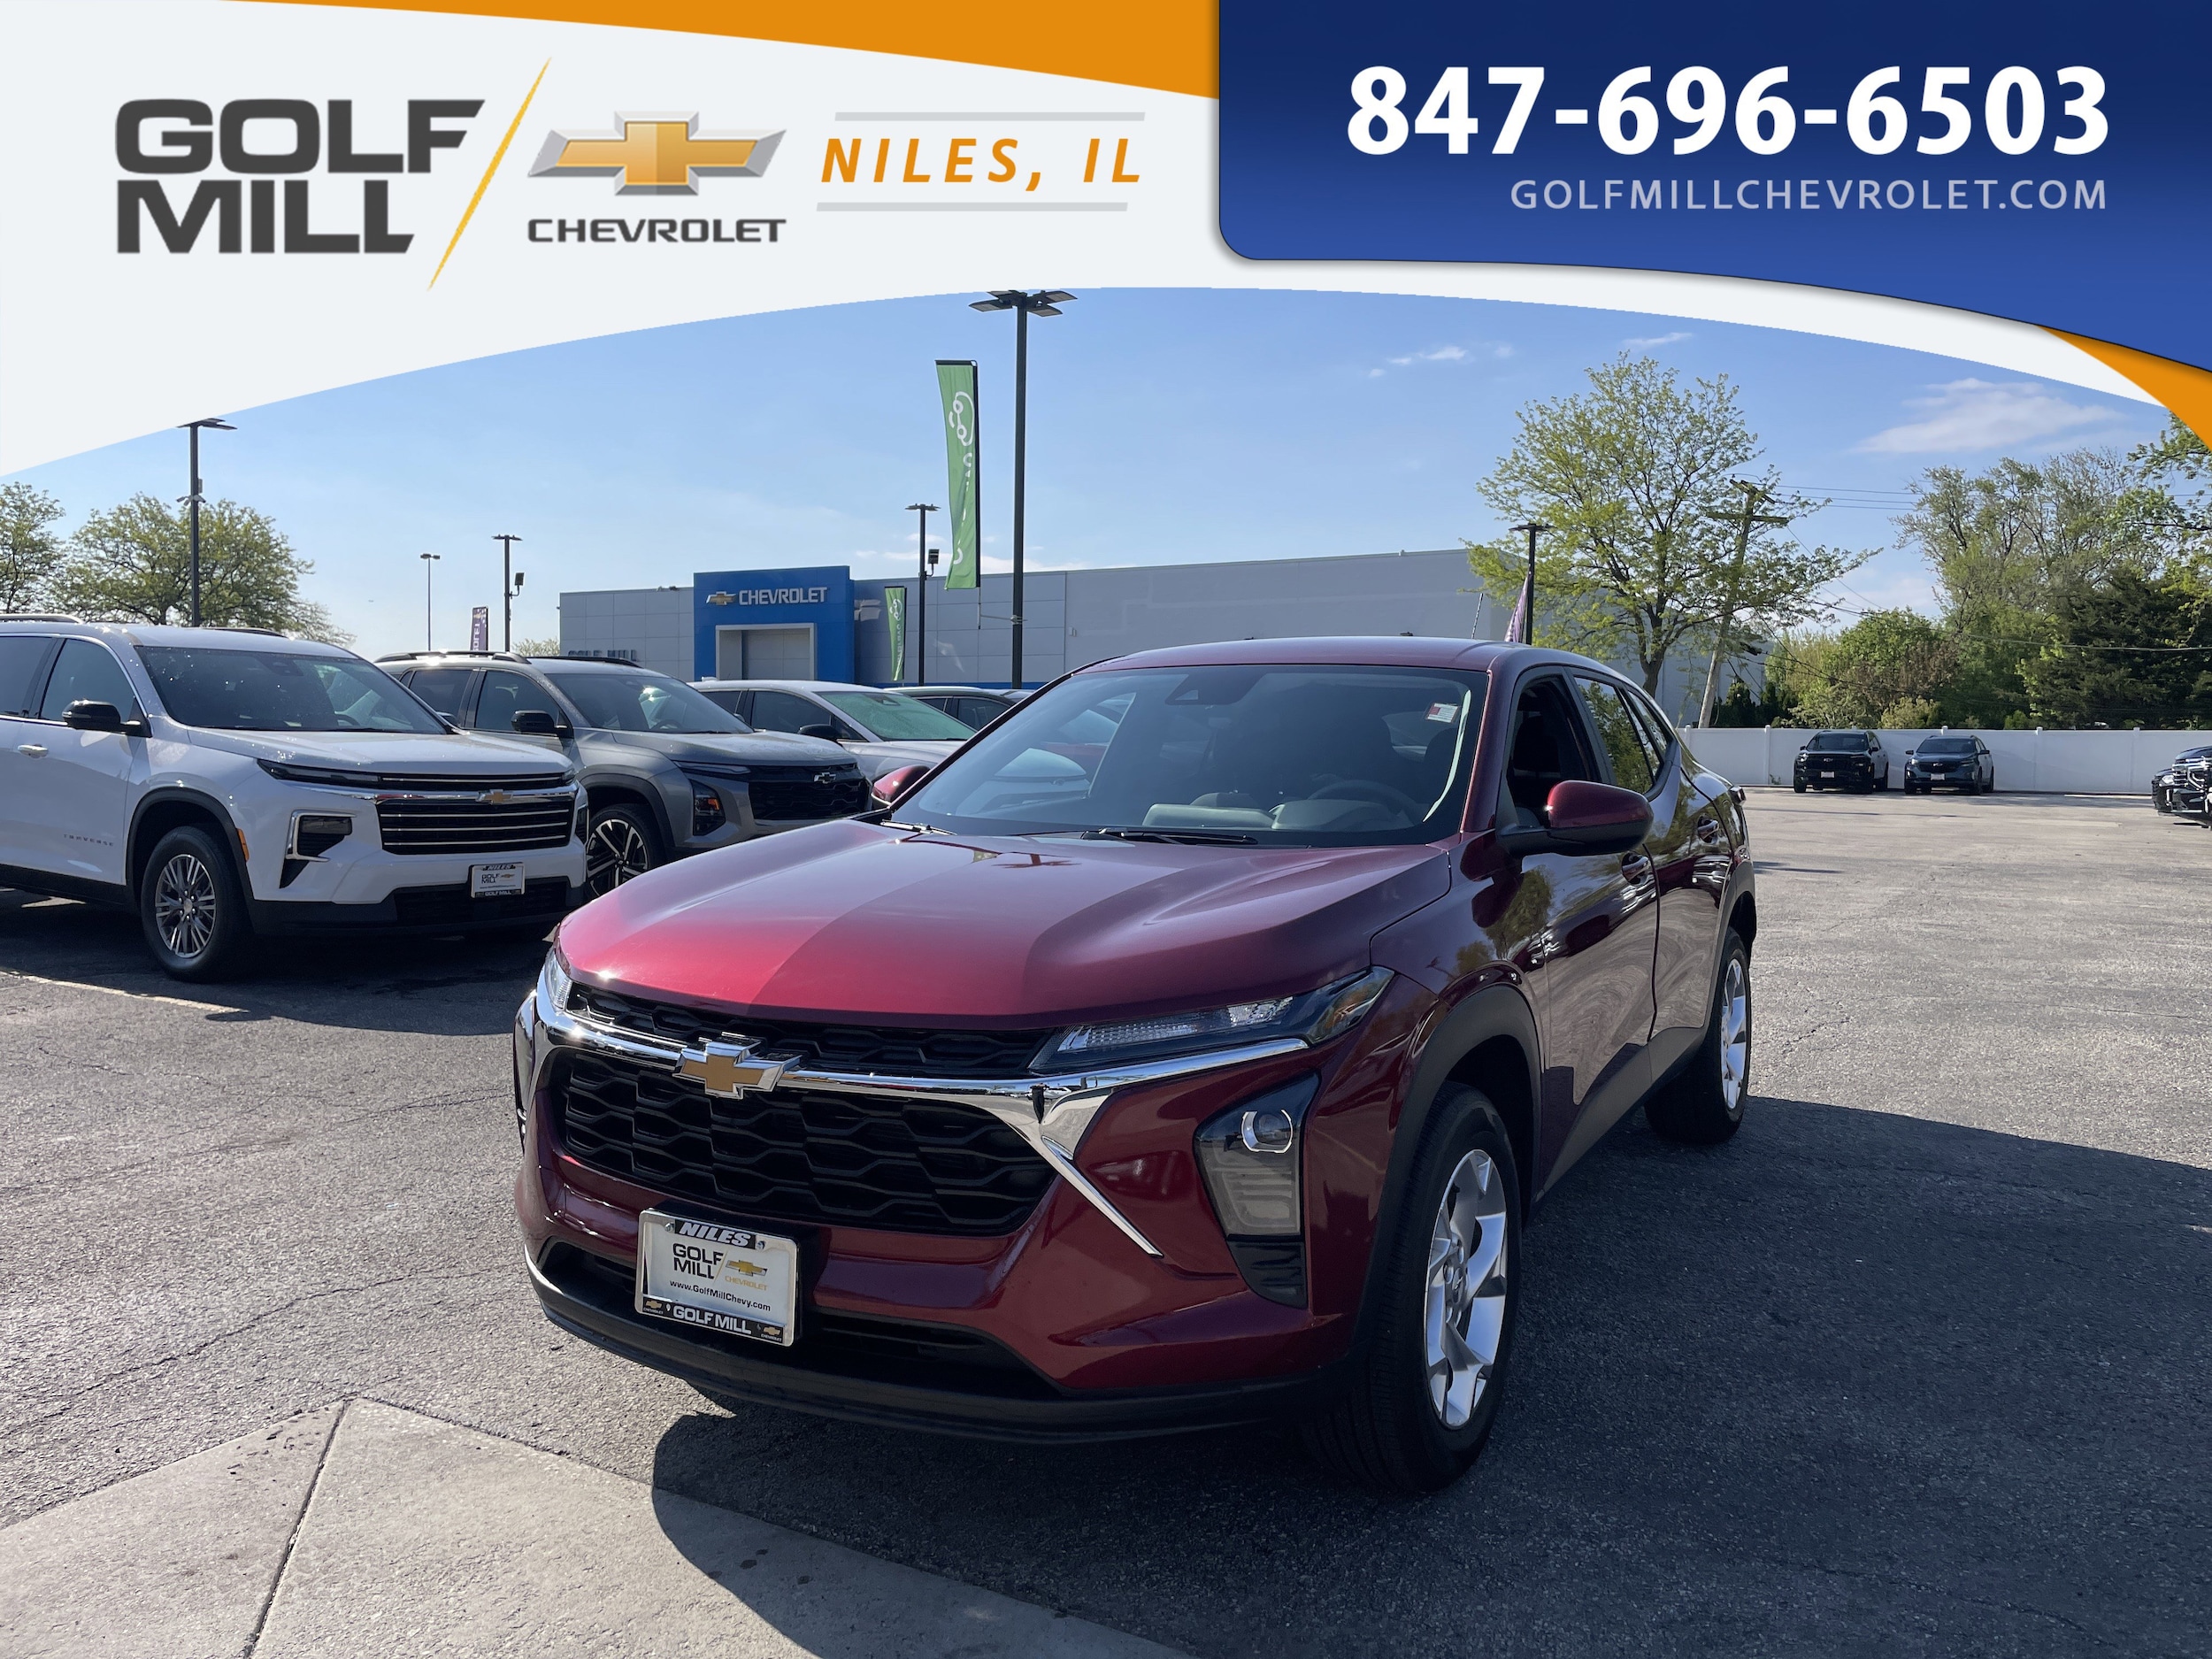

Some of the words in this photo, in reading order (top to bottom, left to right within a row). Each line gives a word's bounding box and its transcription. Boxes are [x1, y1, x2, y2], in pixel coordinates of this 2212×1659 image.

[739, 587, 828, 606] CHEVROLET
[679, 1222, 752, 1248] NILES
[672, 1243, 724, 1265] GOLF
[673, 1257, 715, 1279] MILL
[725, 1275, 768, 1291] CHEVROLET
[669, 1279, 771, 1312] www.GolfMillChevy.com
[673, 1305, 713, 1325] GOLF
[714, 1313, 752, 1335] MILL
